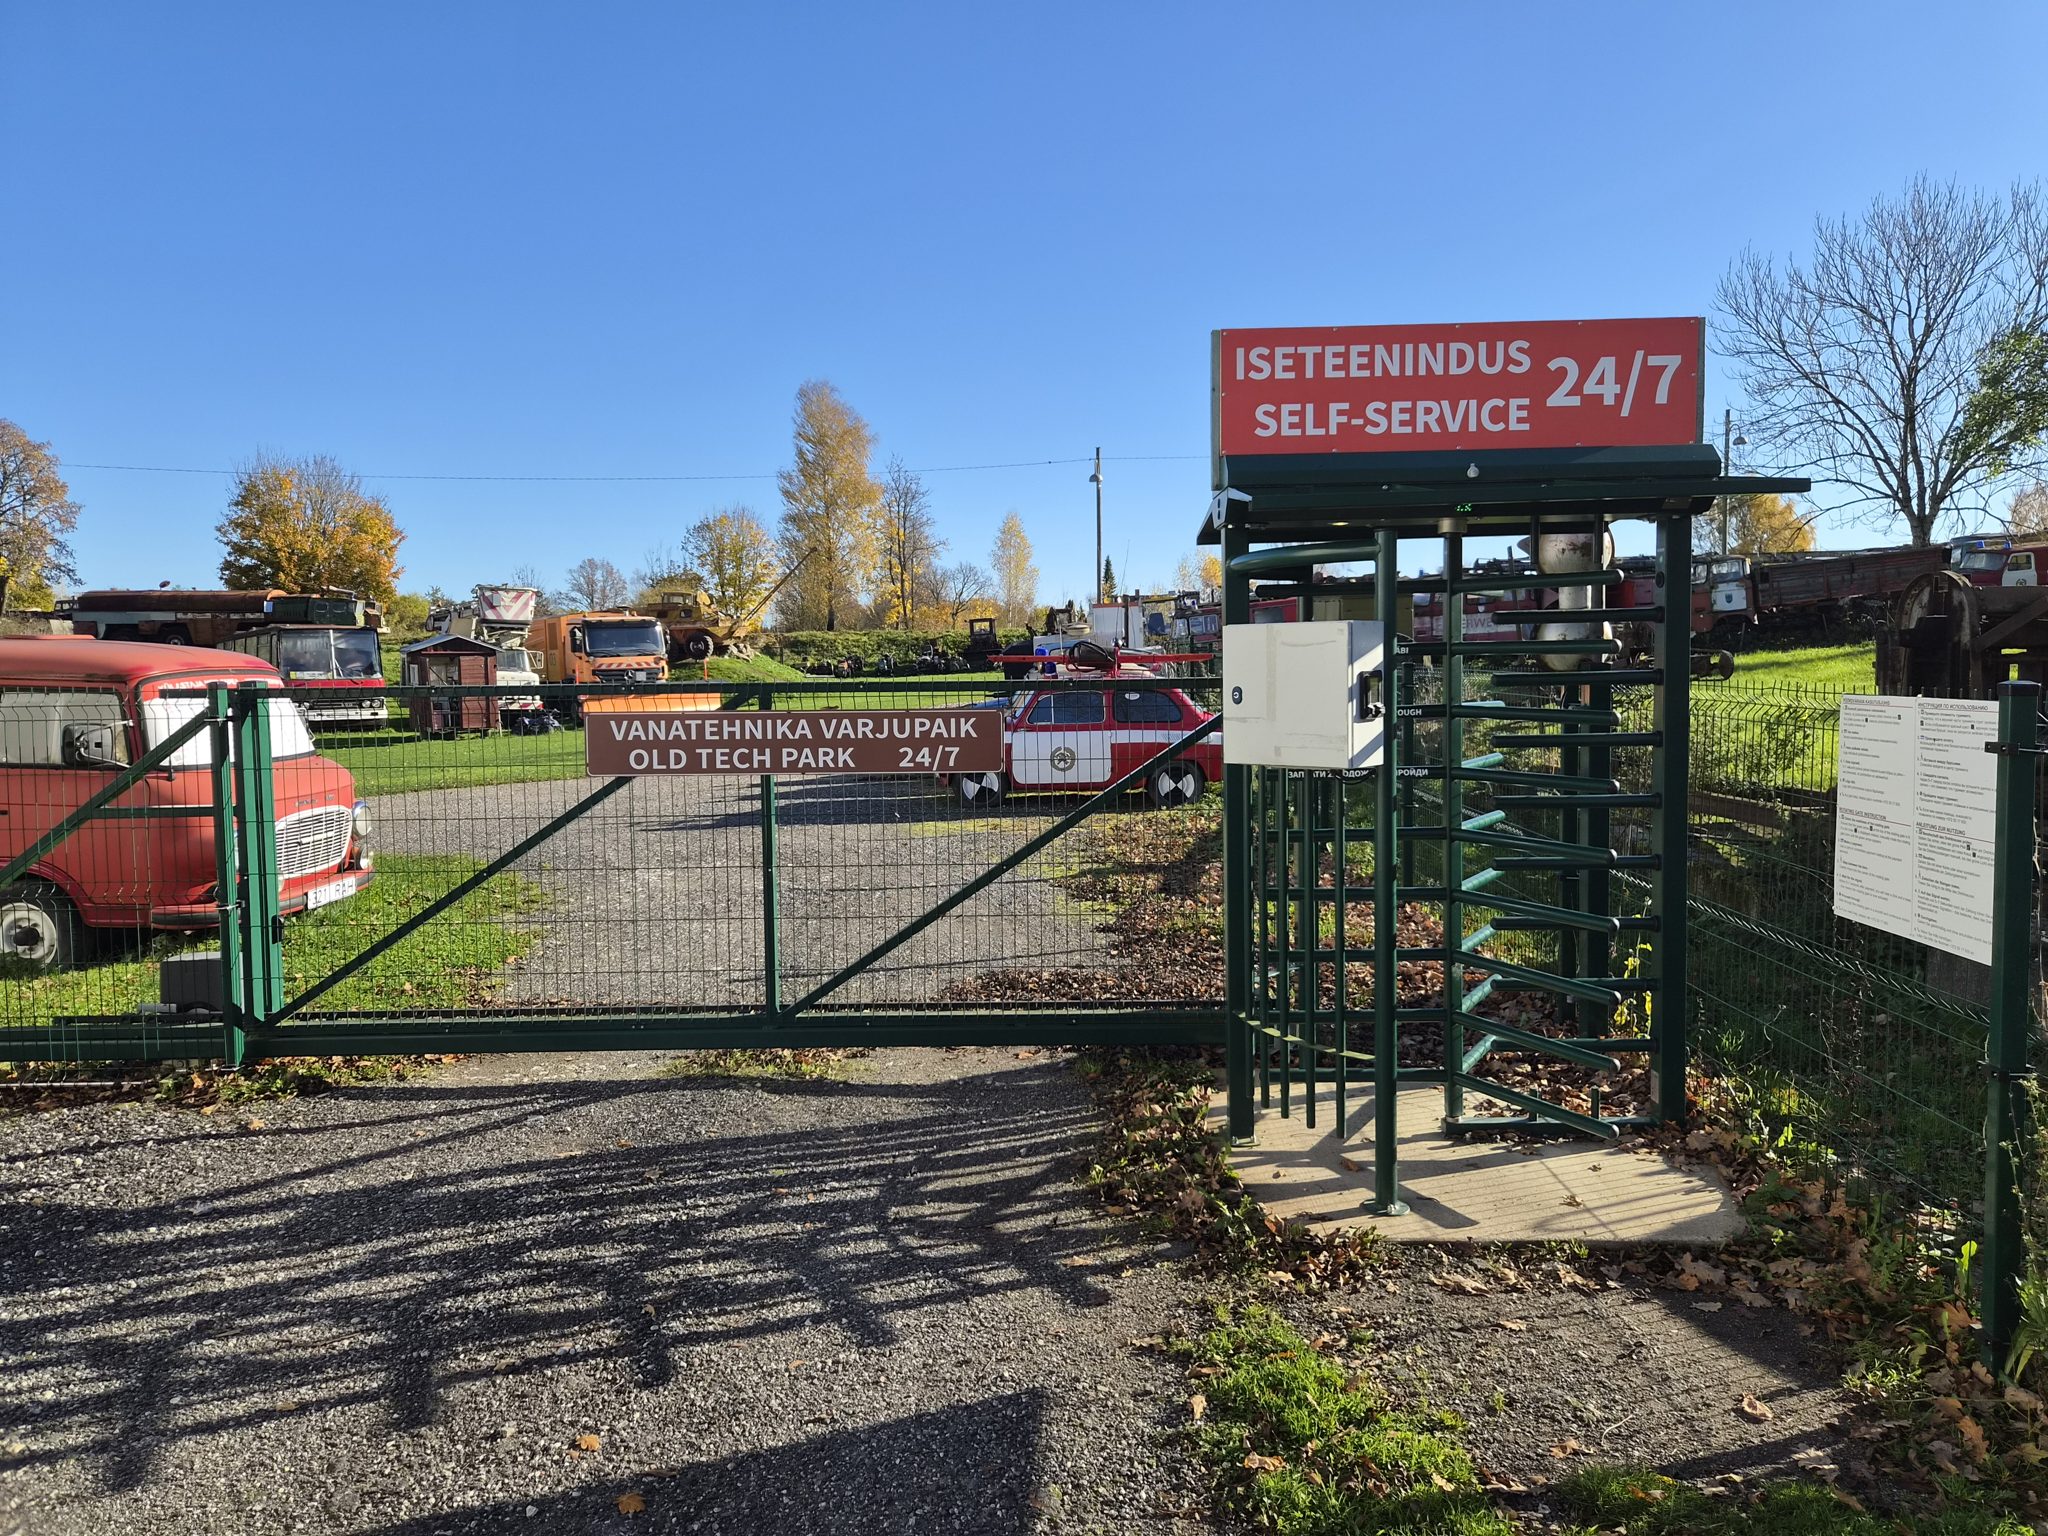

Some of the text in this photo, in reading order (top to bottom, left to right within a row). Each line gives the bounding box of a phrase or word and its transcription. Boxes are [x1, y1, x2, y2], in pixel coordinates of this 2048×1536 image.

[1237, 341, 1530, 380] ISETEENINDUS
[1547, 351, 1681, 416] 24/7
[1255, 398, 1529, 437] SELF-SERVICE
[609, 717, 977, 741] VANATEHNIKA VARJUPAIK
[628, 745, 960, 771] OLD TECH PARK 24/7
